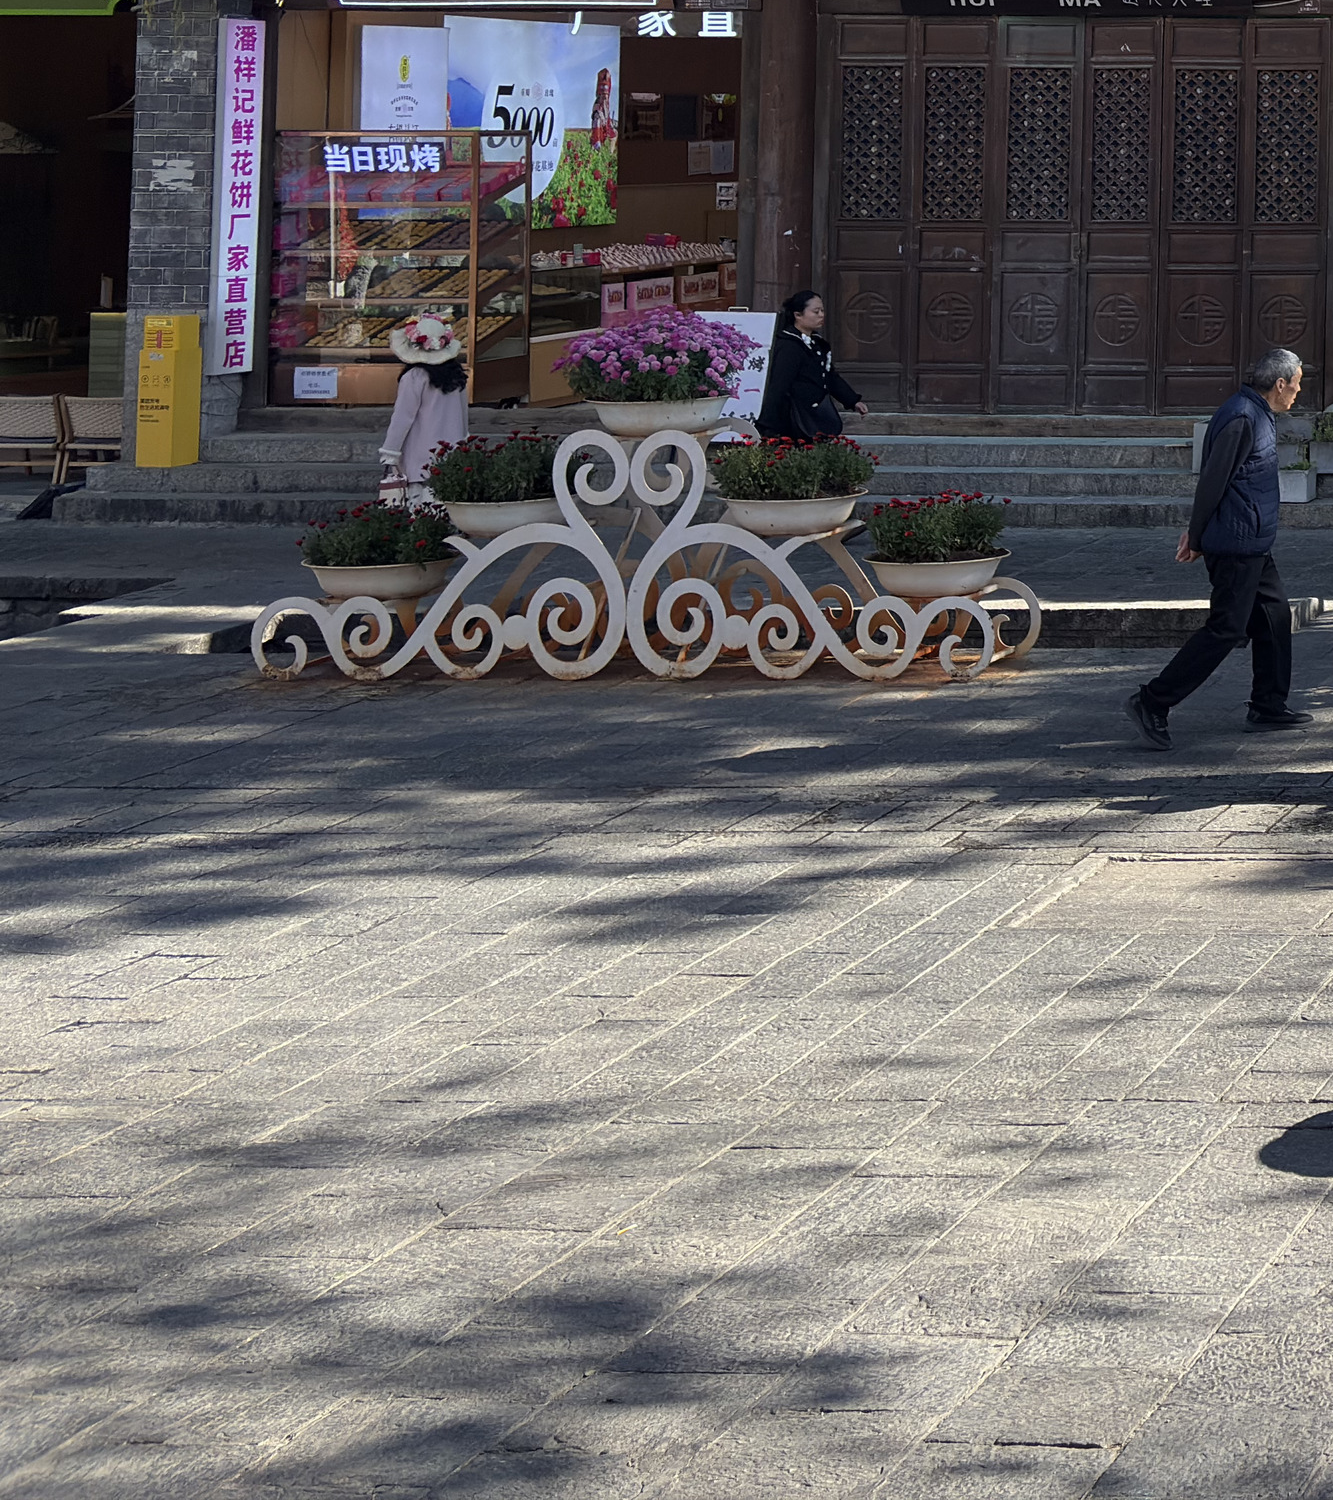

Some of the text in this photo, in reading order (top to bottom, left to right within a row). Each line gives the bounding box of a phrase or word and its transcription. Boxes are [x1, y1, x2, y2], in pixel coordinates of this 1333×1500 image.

[571, 11, 738, 37] 家直
[486, 83, 555, 149] 5000
[323, 143, 441, 174] 当日现烤
[222, 24, 258, 369] 潘祥记鲜花饼厂家直营店
